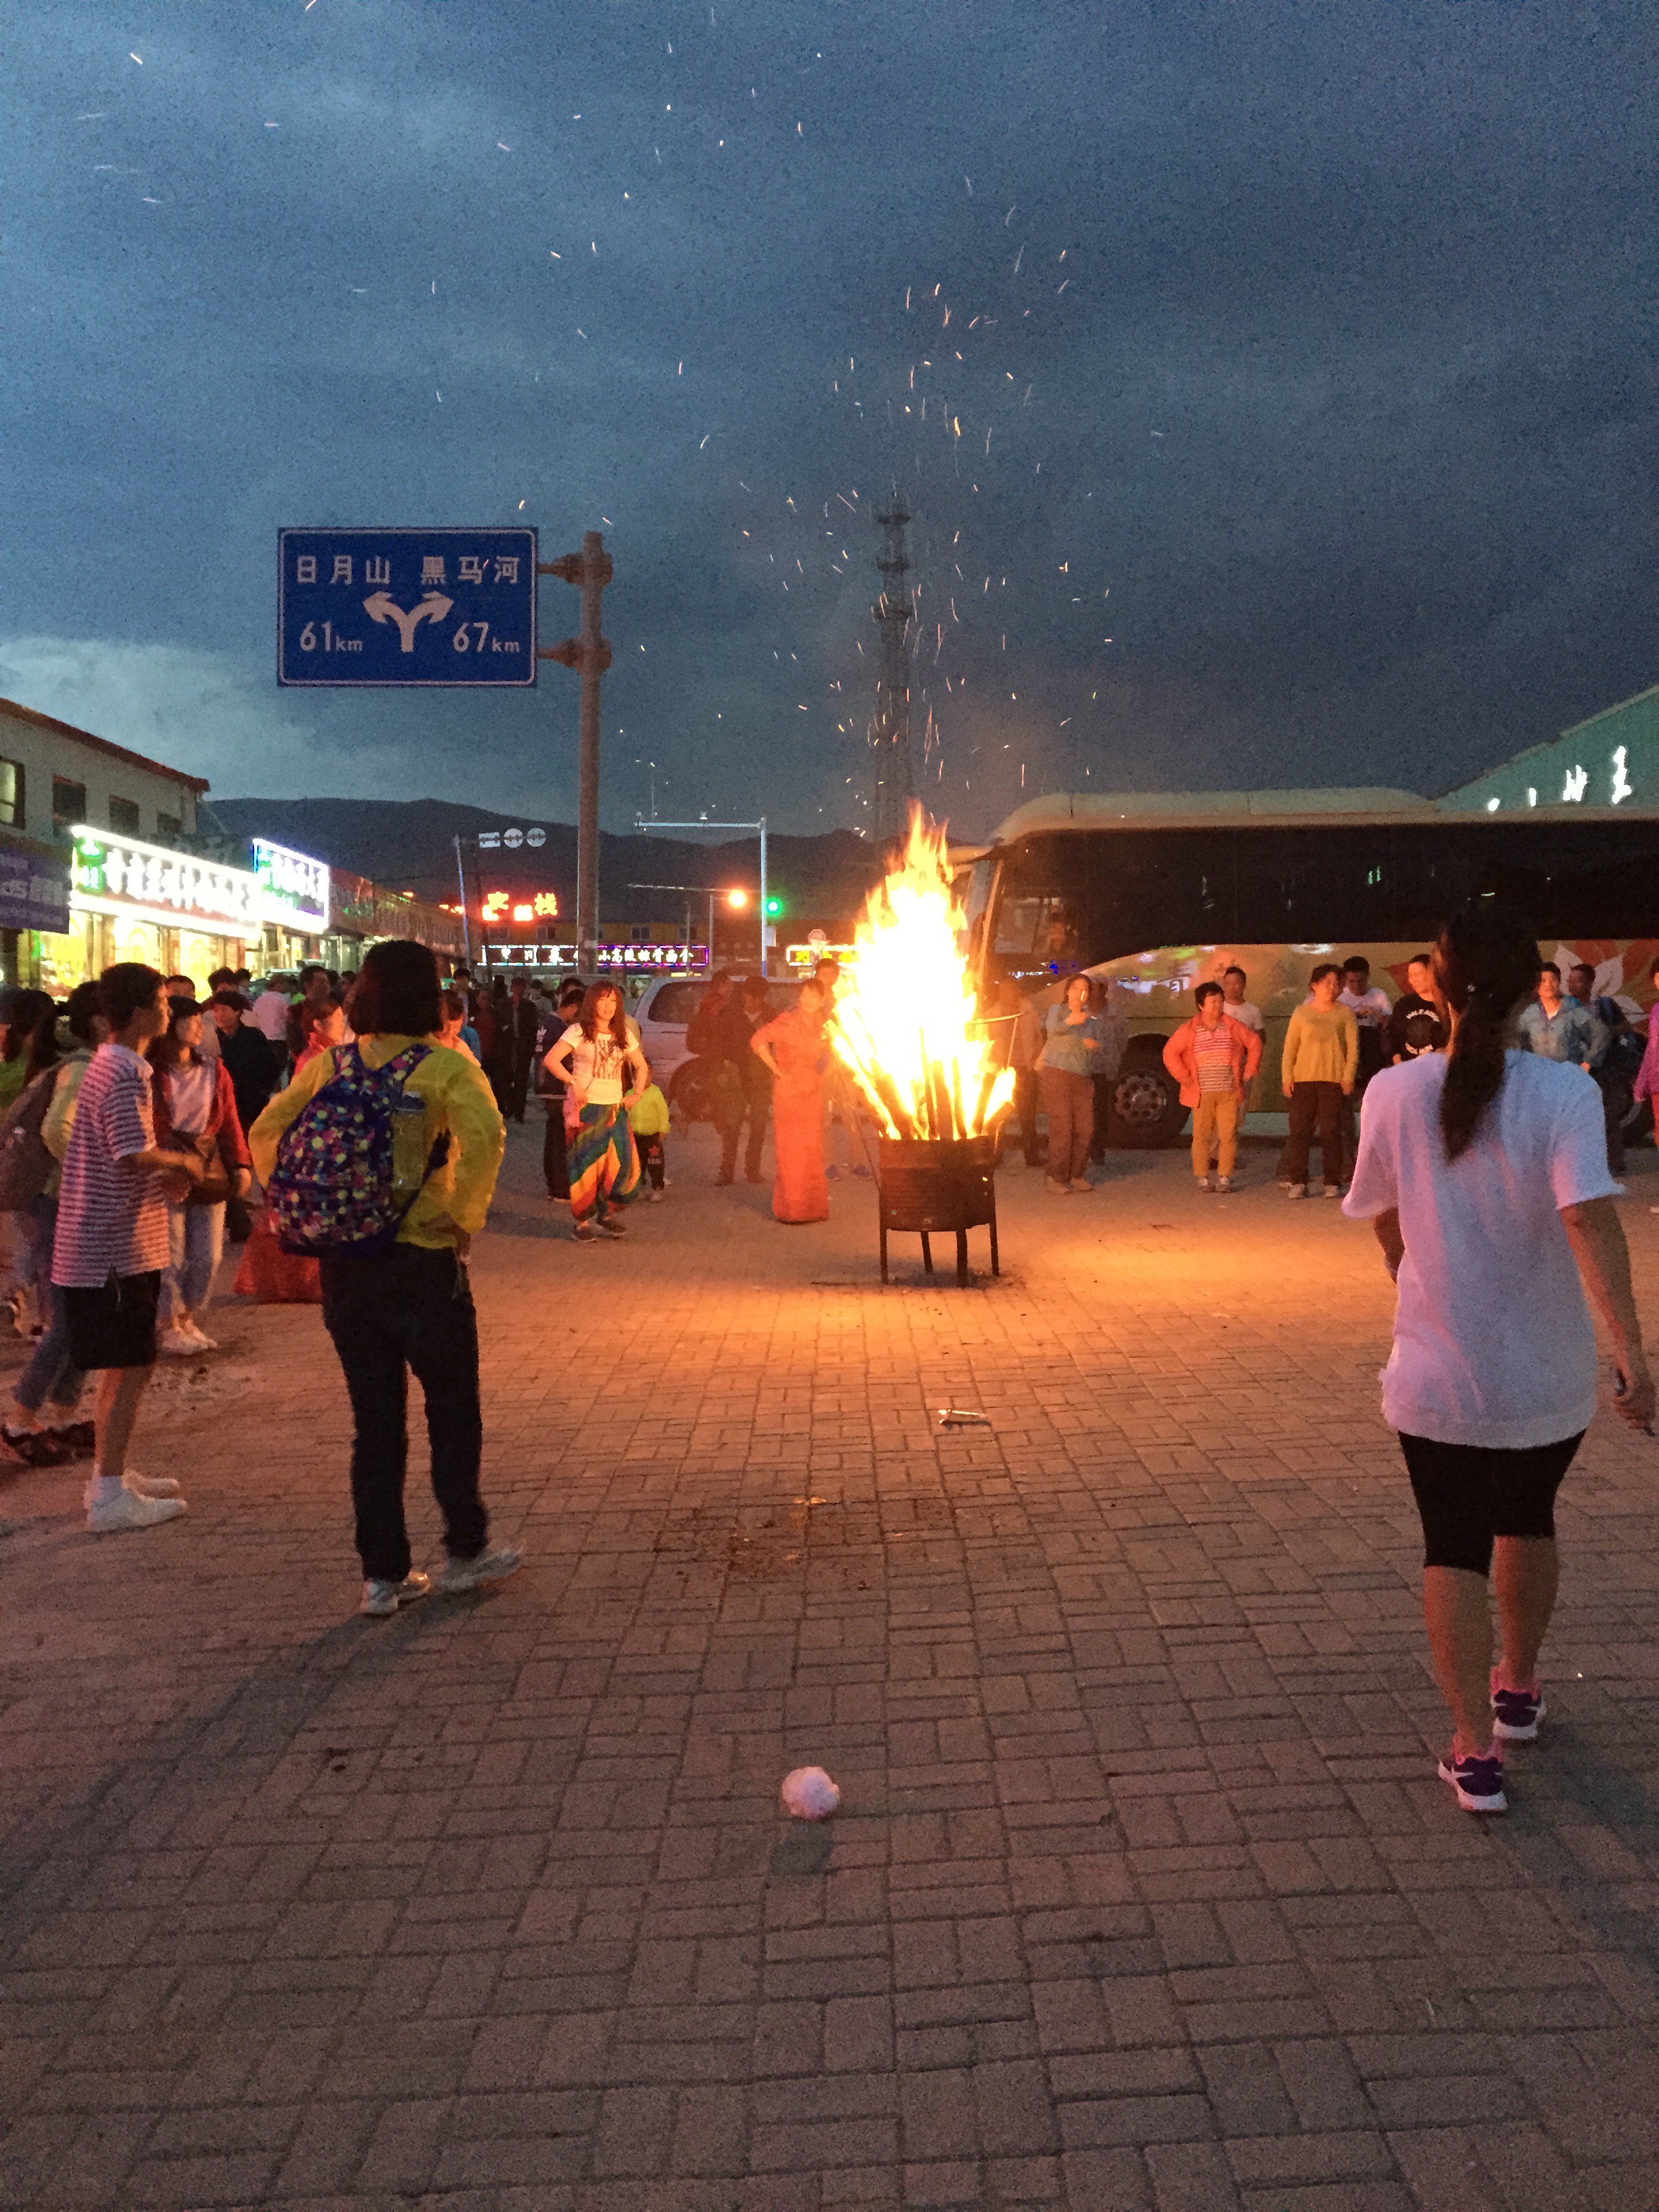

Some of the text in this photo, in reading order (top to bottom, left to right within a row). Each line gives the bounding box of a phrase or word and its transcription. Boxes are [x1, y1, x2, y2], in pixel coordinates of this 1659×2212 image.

[296, 554, 520, 585] 日月山 黑马河
[300, 621, 520, 653] 61km 67km
